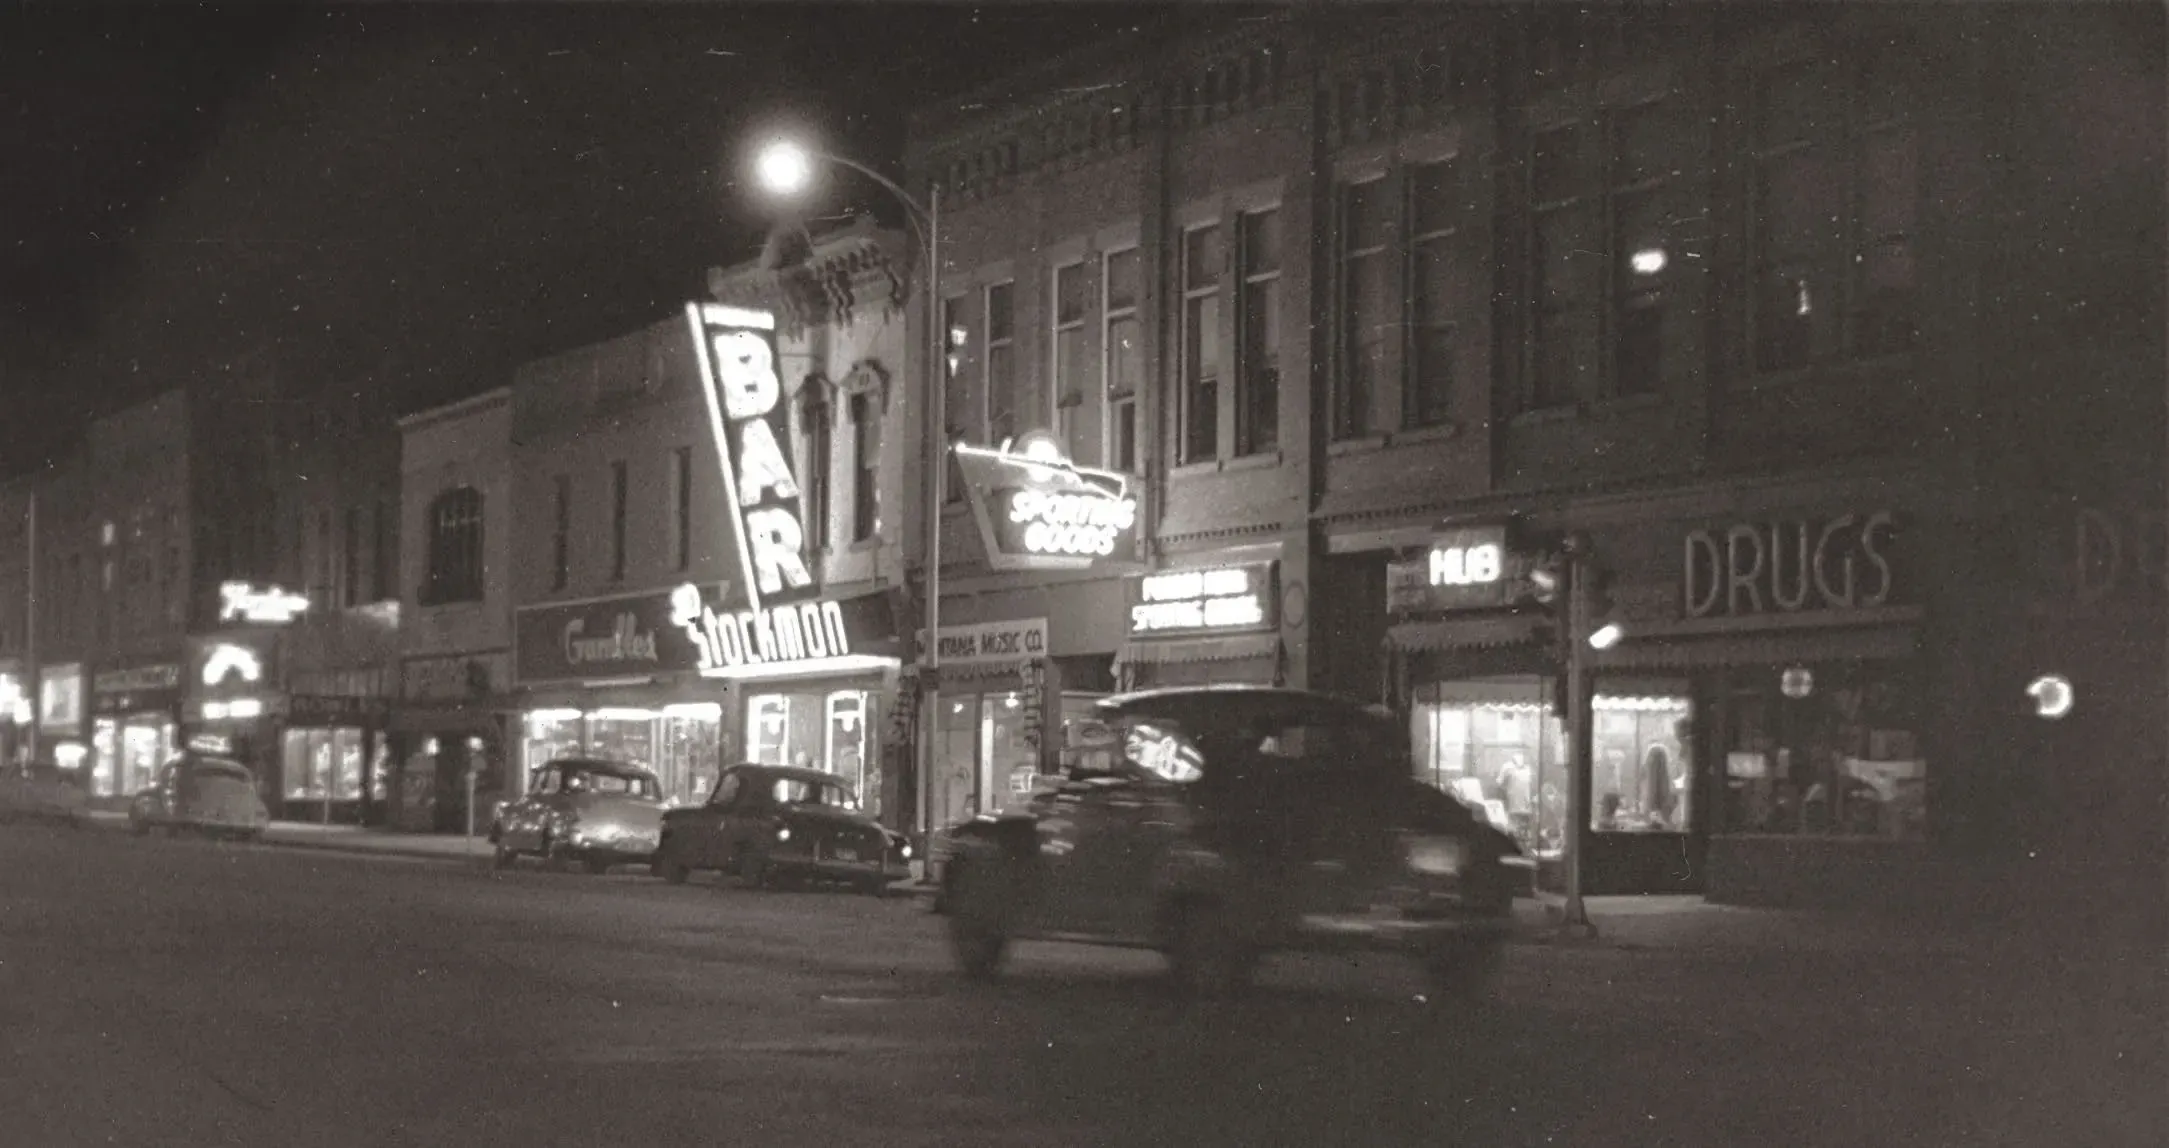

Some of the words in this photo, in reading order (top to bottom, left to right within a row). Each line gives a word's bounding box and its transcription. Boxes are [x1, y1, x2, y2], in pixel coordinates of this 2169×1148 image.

[713, 330, 811, 594] BAR
[1010, 490, 1136, 529] SPORTING
[1025, 519, 1118, 555] GOODS
[1430, 543, 1500, 585] HUB
[1684, 510, 1892, 617] DRUGS
[980, 630, 1020, 655] MUSIC
